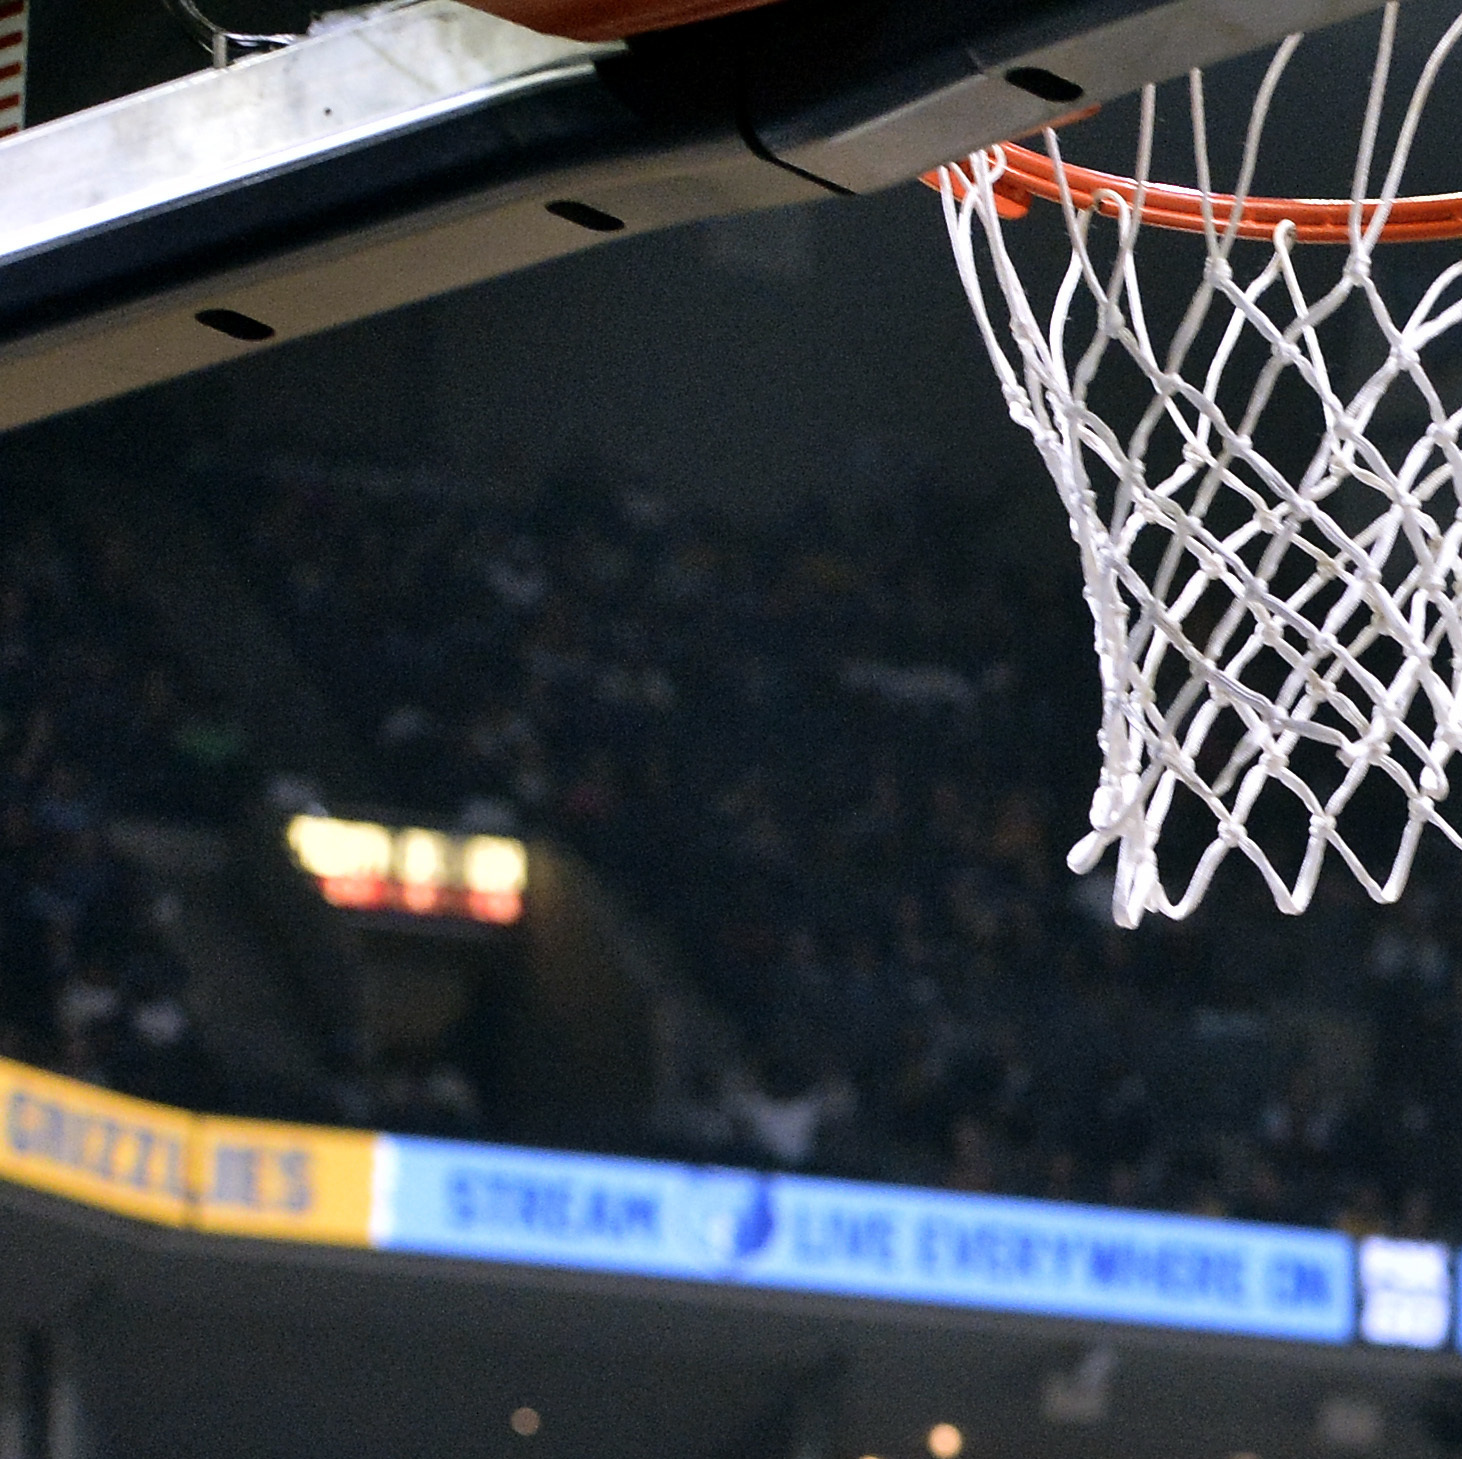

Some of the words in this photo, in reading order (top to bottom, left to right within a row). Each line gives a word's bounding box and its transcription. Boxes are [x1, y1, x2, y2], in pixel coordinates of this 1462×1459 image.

[445, 1164, 661, 1240] STREAM
[796, 1205, 896, 1275] LIVE
[917, 1211, 1247, 1304] EVERYWHERE
[1268, 1253, 1334, 1307] ON
